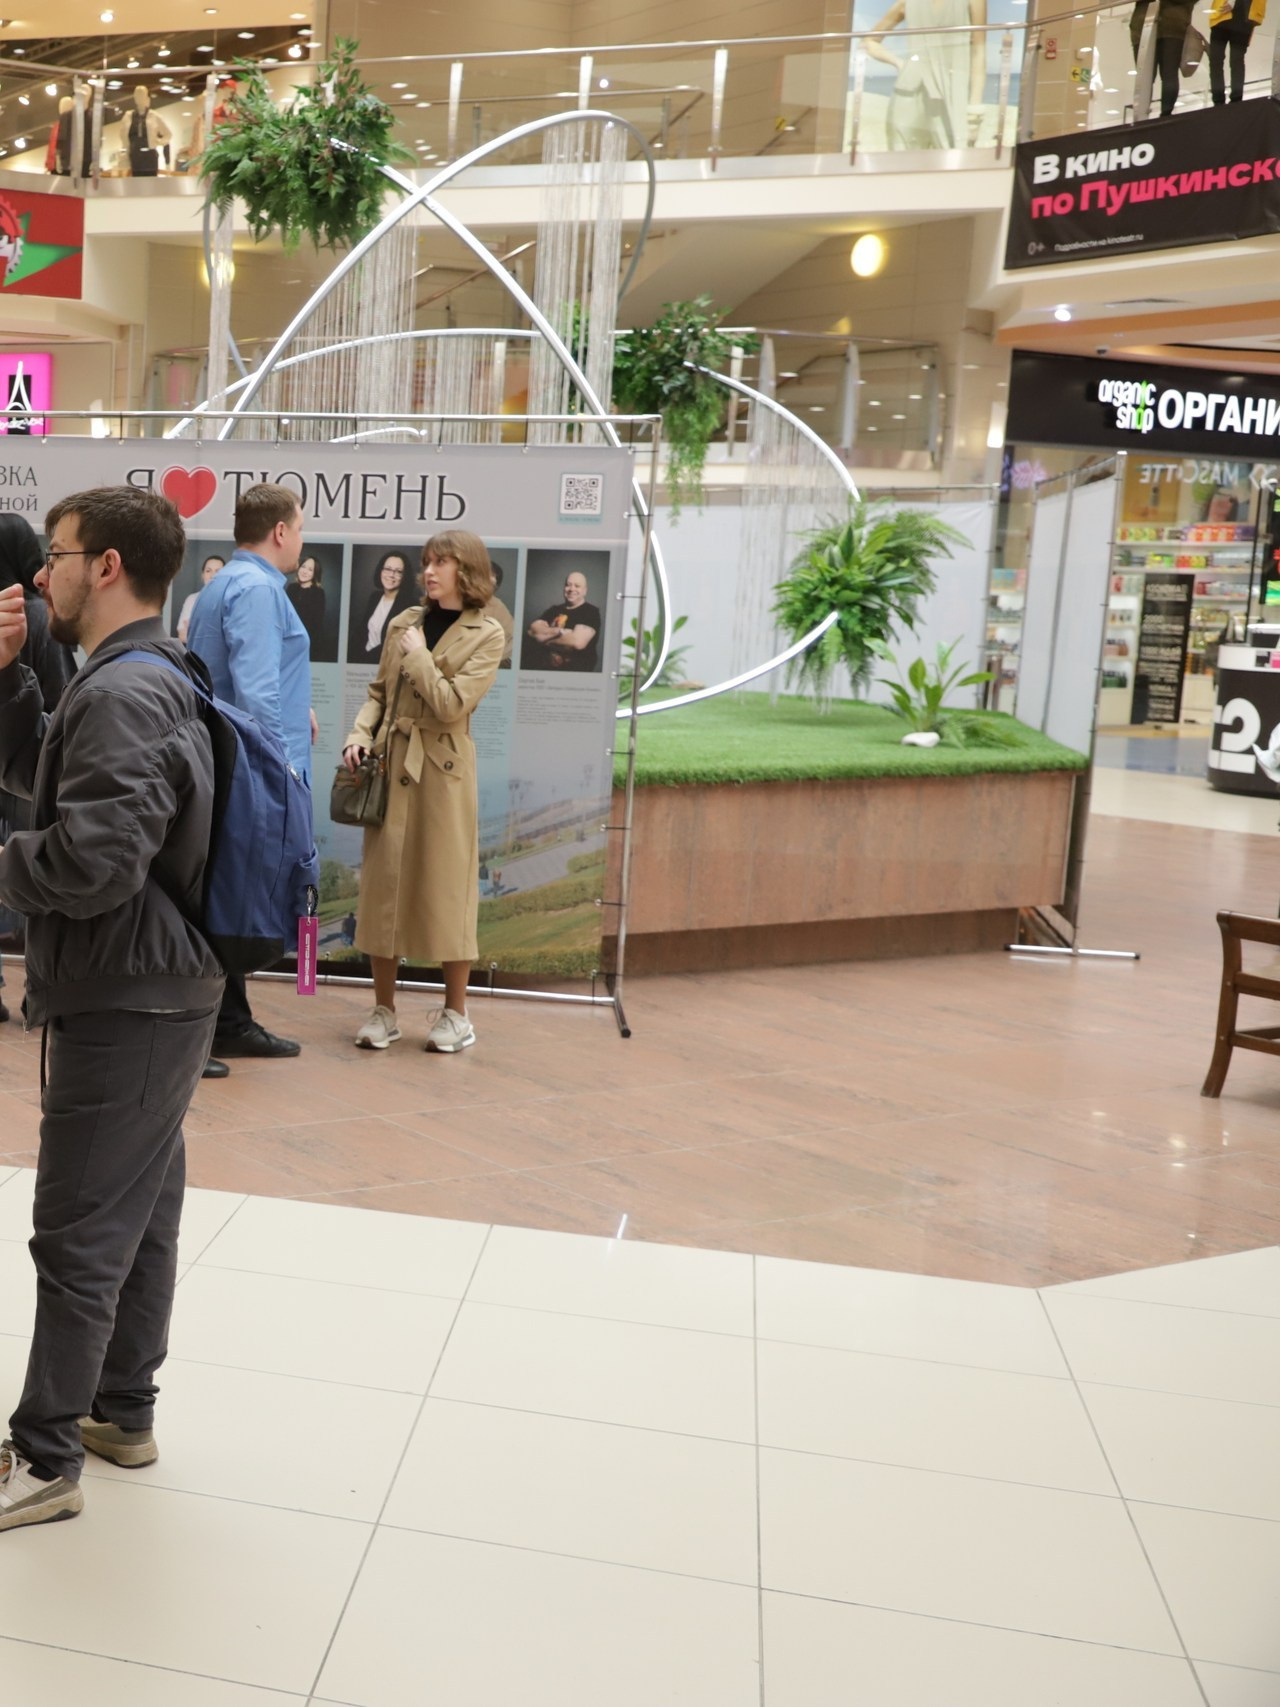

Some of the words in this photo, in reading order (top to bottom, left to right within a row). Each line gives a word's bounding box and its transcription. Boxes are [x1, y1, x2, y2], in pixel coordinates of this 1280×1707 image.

[1033, 154, 1059, 185] В
[1031, 193, 1075, 219] по
[1080, 156, 1280, 217] Пушкинск
[1098, 378, 1157, 408] organic
[1116, 403, 1155, 434] shop
